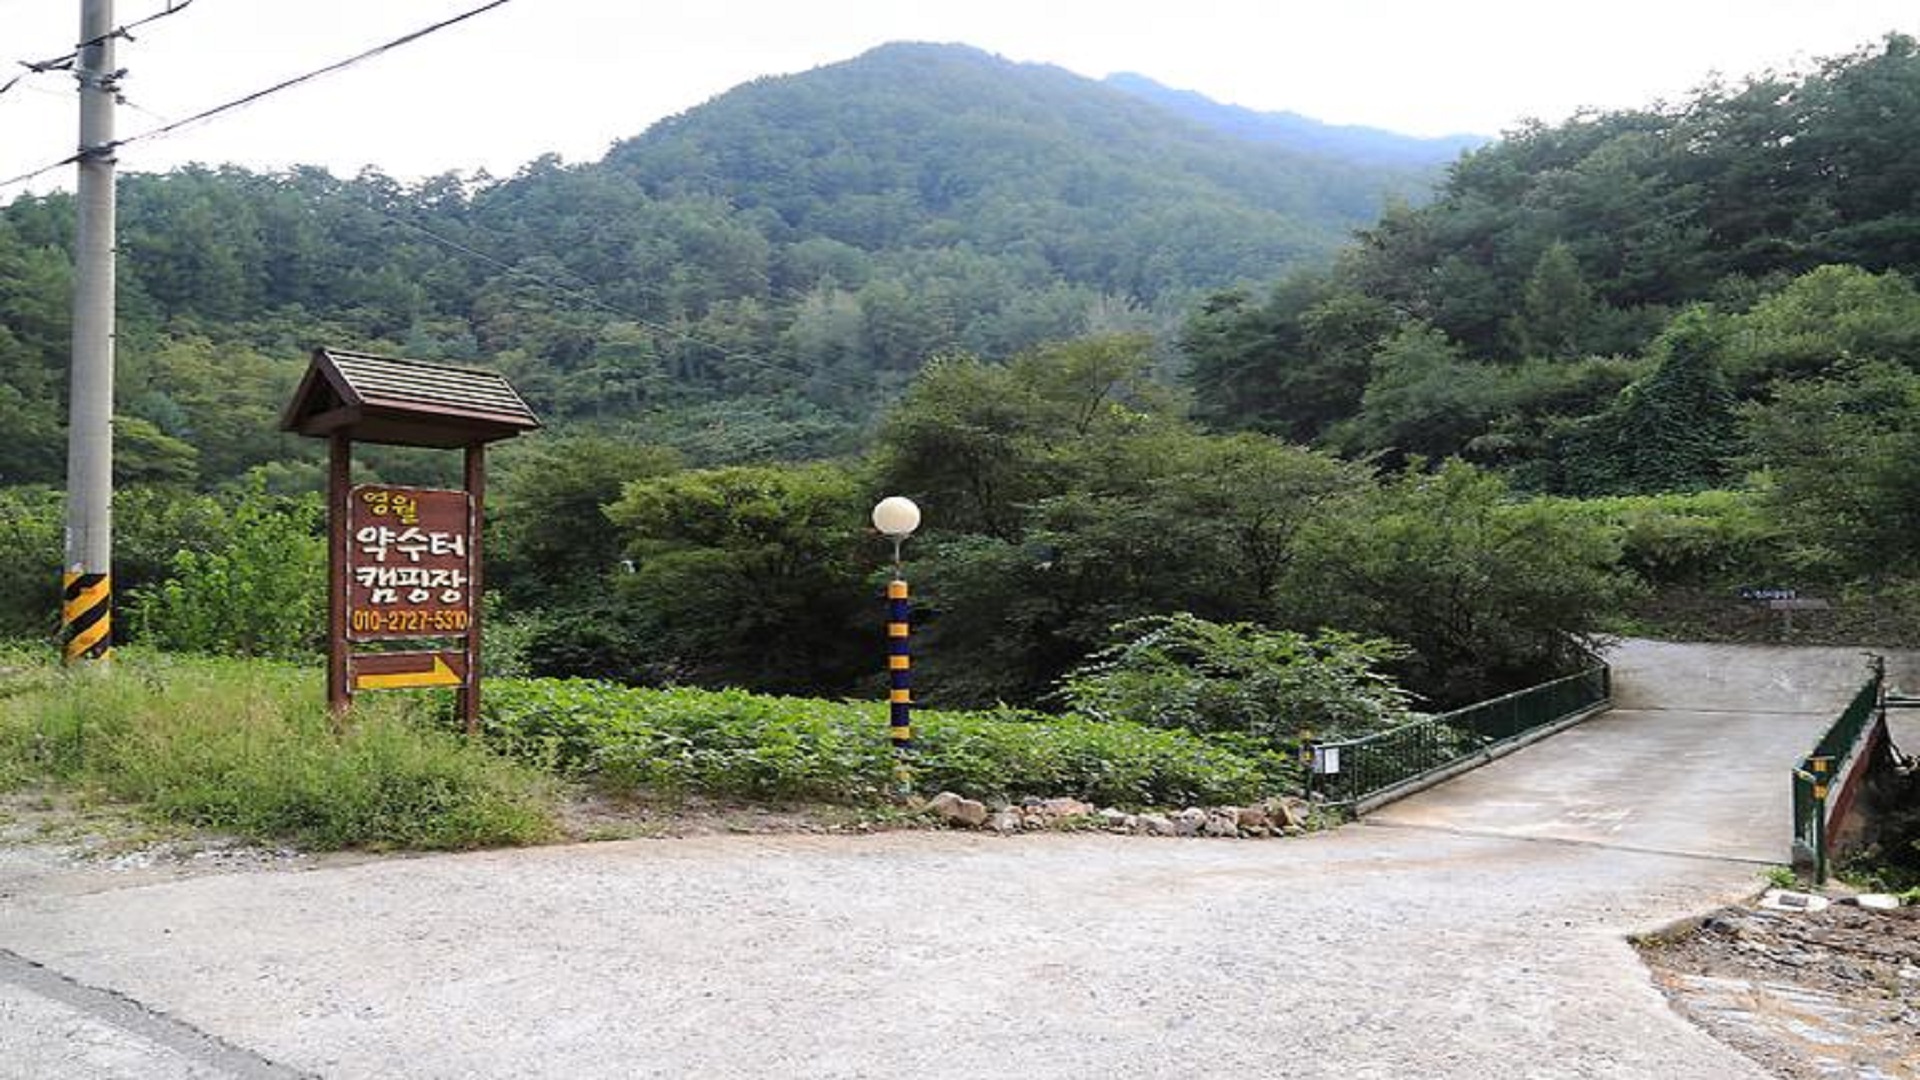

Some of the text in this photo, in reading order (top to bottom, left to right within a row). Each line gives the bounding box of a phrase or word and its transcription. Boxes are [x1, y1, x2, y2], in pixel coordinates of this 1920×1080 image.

[363, 491, 419, 524] 영월
[356, 526, 465, 562] 약수터
[355, 566, 467, 603] 캠핑장
